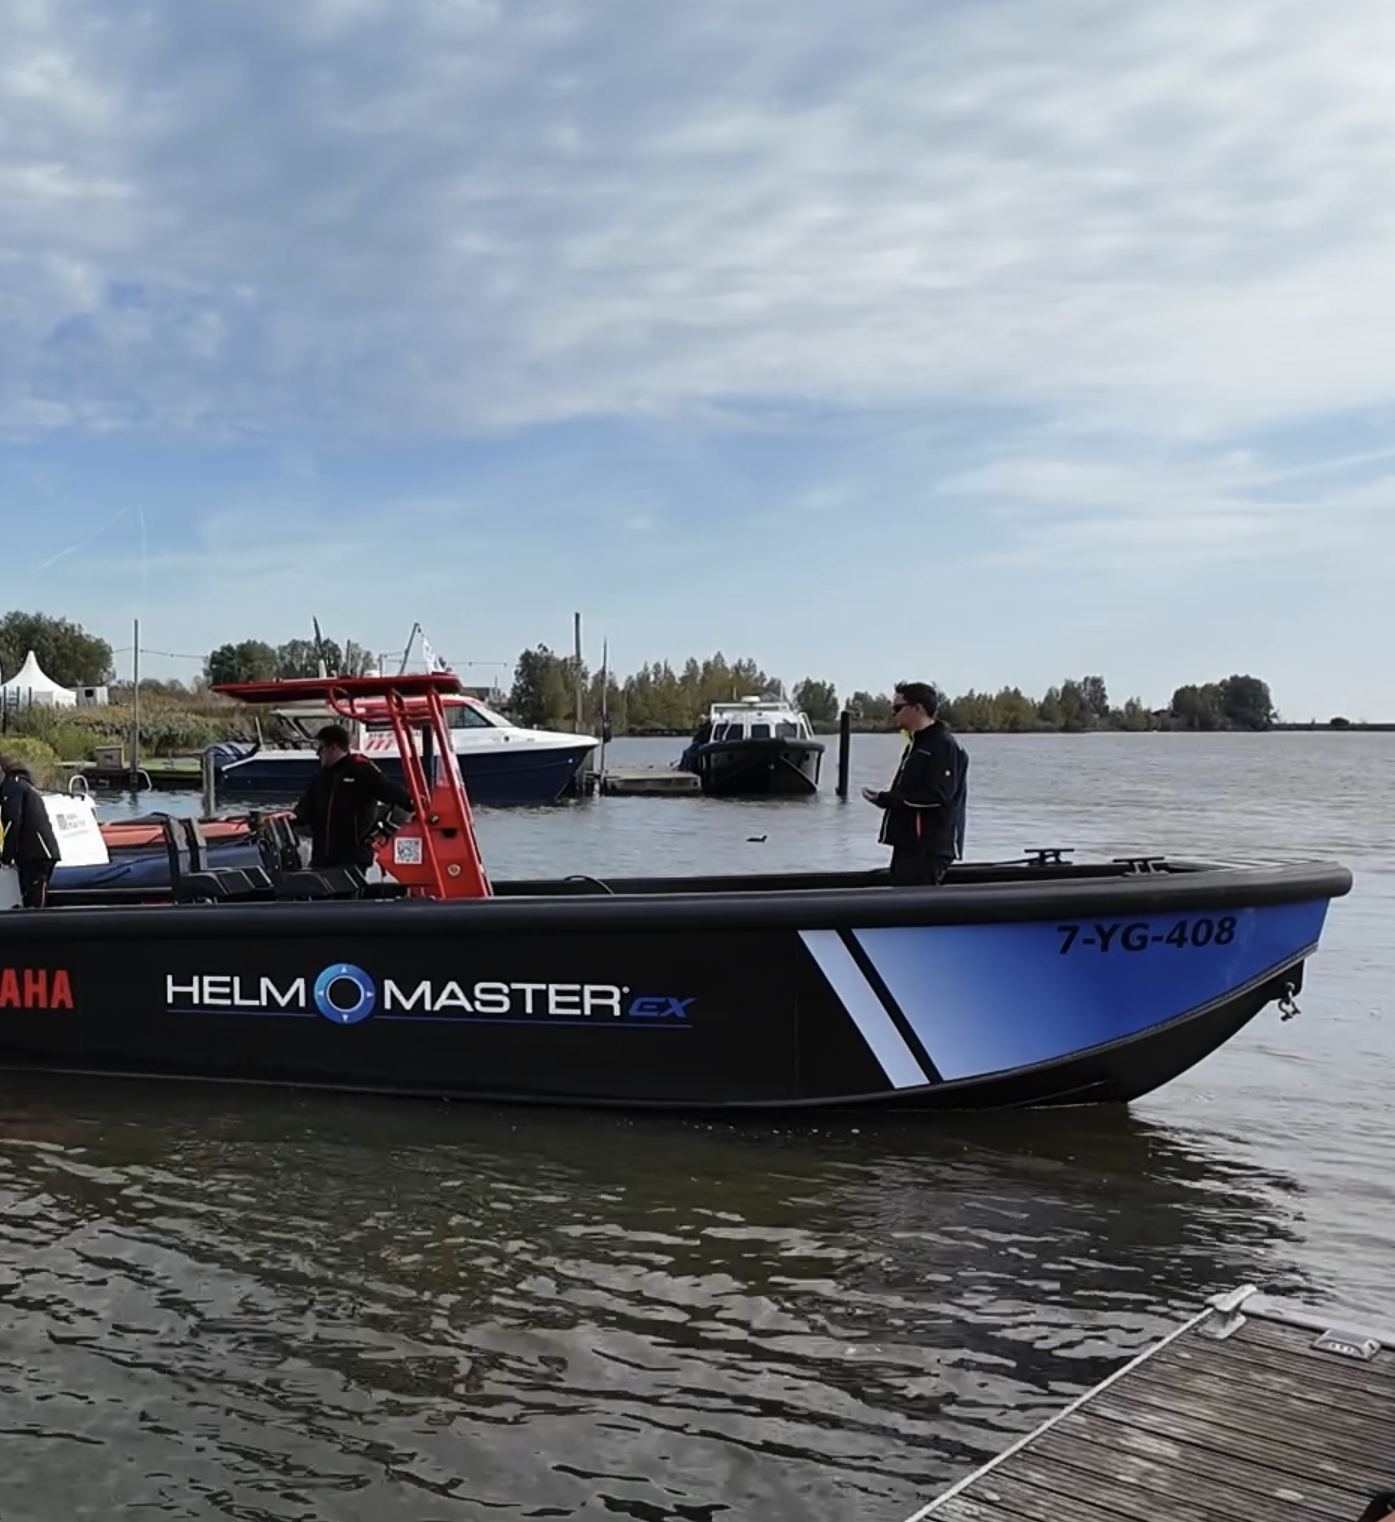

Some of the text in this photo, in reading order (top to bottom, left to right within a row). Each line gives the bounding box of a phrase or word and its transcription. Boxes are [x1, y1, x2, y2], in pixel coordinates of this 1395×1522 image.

[1057, 916, 1238, 955] 7-YG-408
[166, 974, 306, 1008] HELM
[628, 997, 697, 1018] EX
